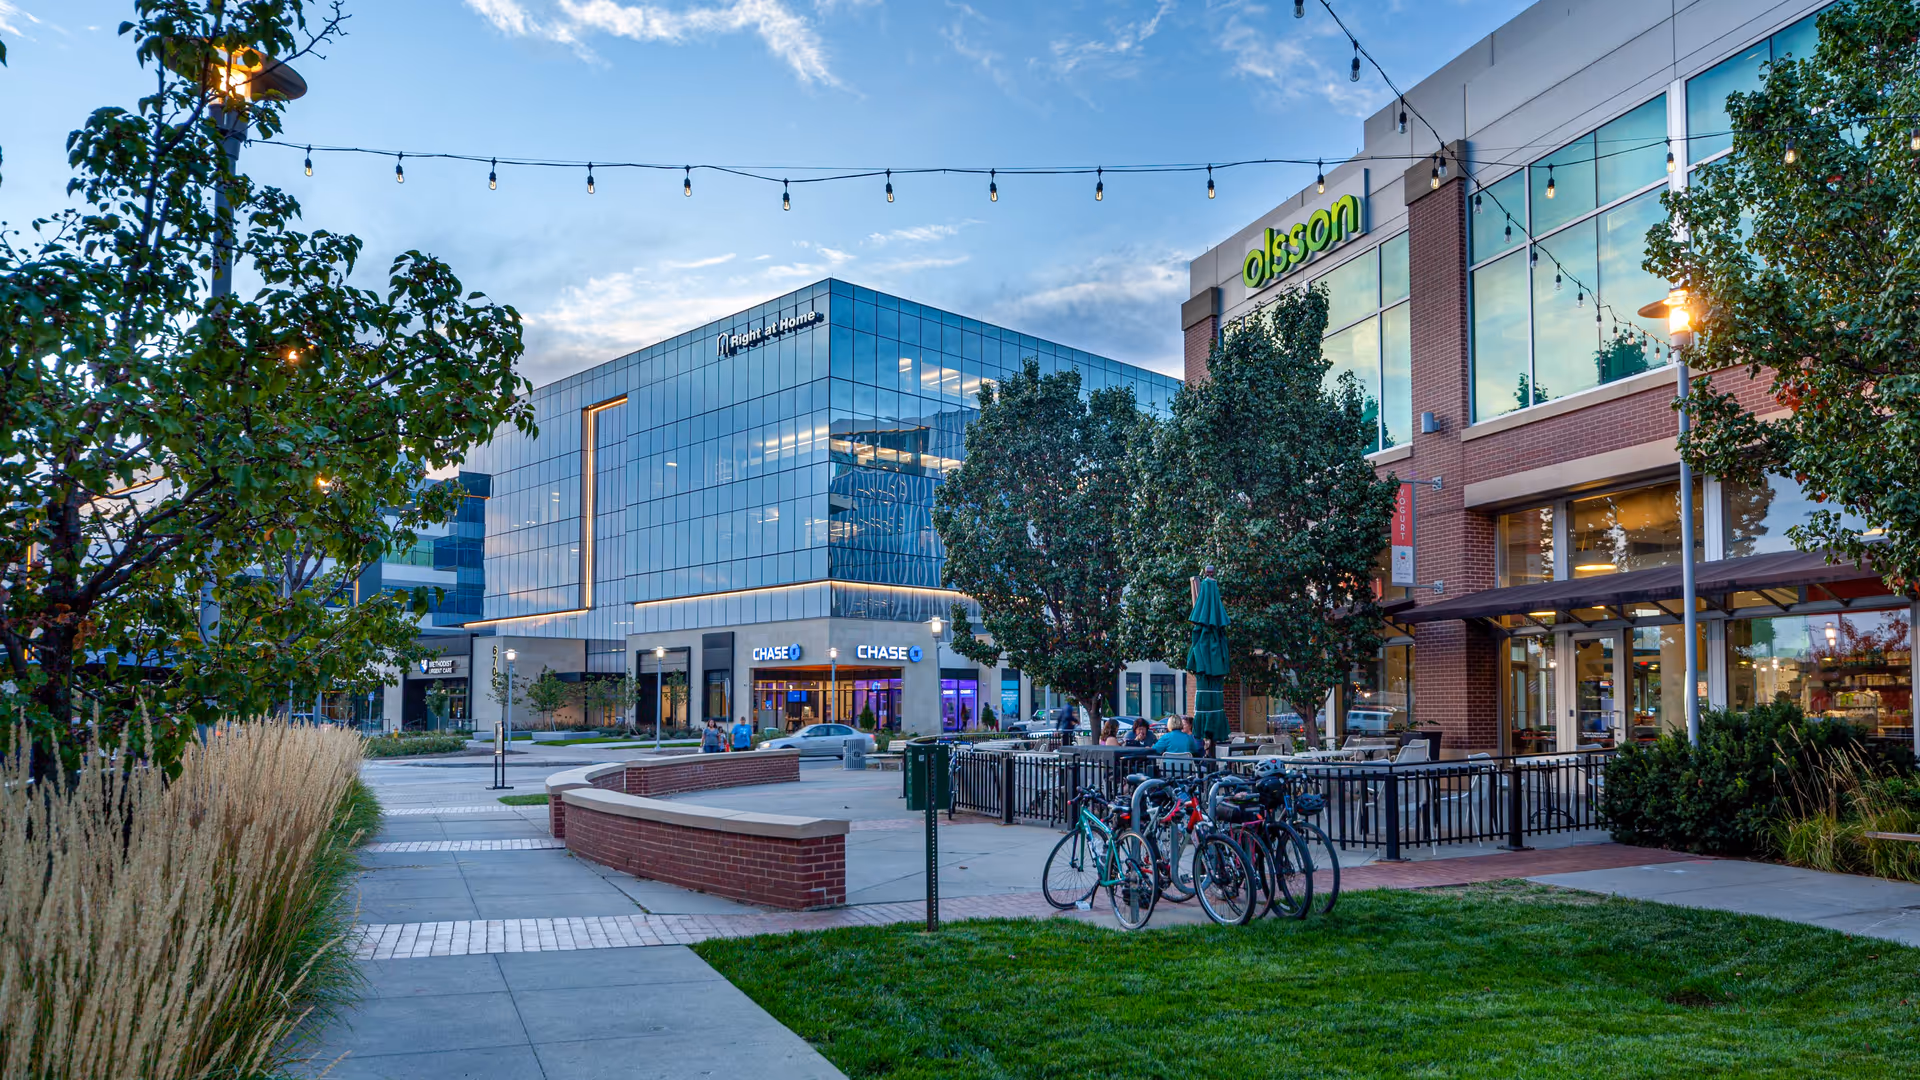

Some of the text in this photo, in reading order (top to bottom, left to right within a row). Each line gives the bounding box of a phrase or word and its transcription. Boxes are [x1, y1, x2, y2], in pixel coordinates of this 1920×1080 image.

[1242, 194, 1358, 288] olsson
[731, 311, 816, 348] Right at Home
[752, 646, 789, 661] CHASE
[857, 645, 908, 660] CHASE
[429, 660, 452, 668] METHODIST
